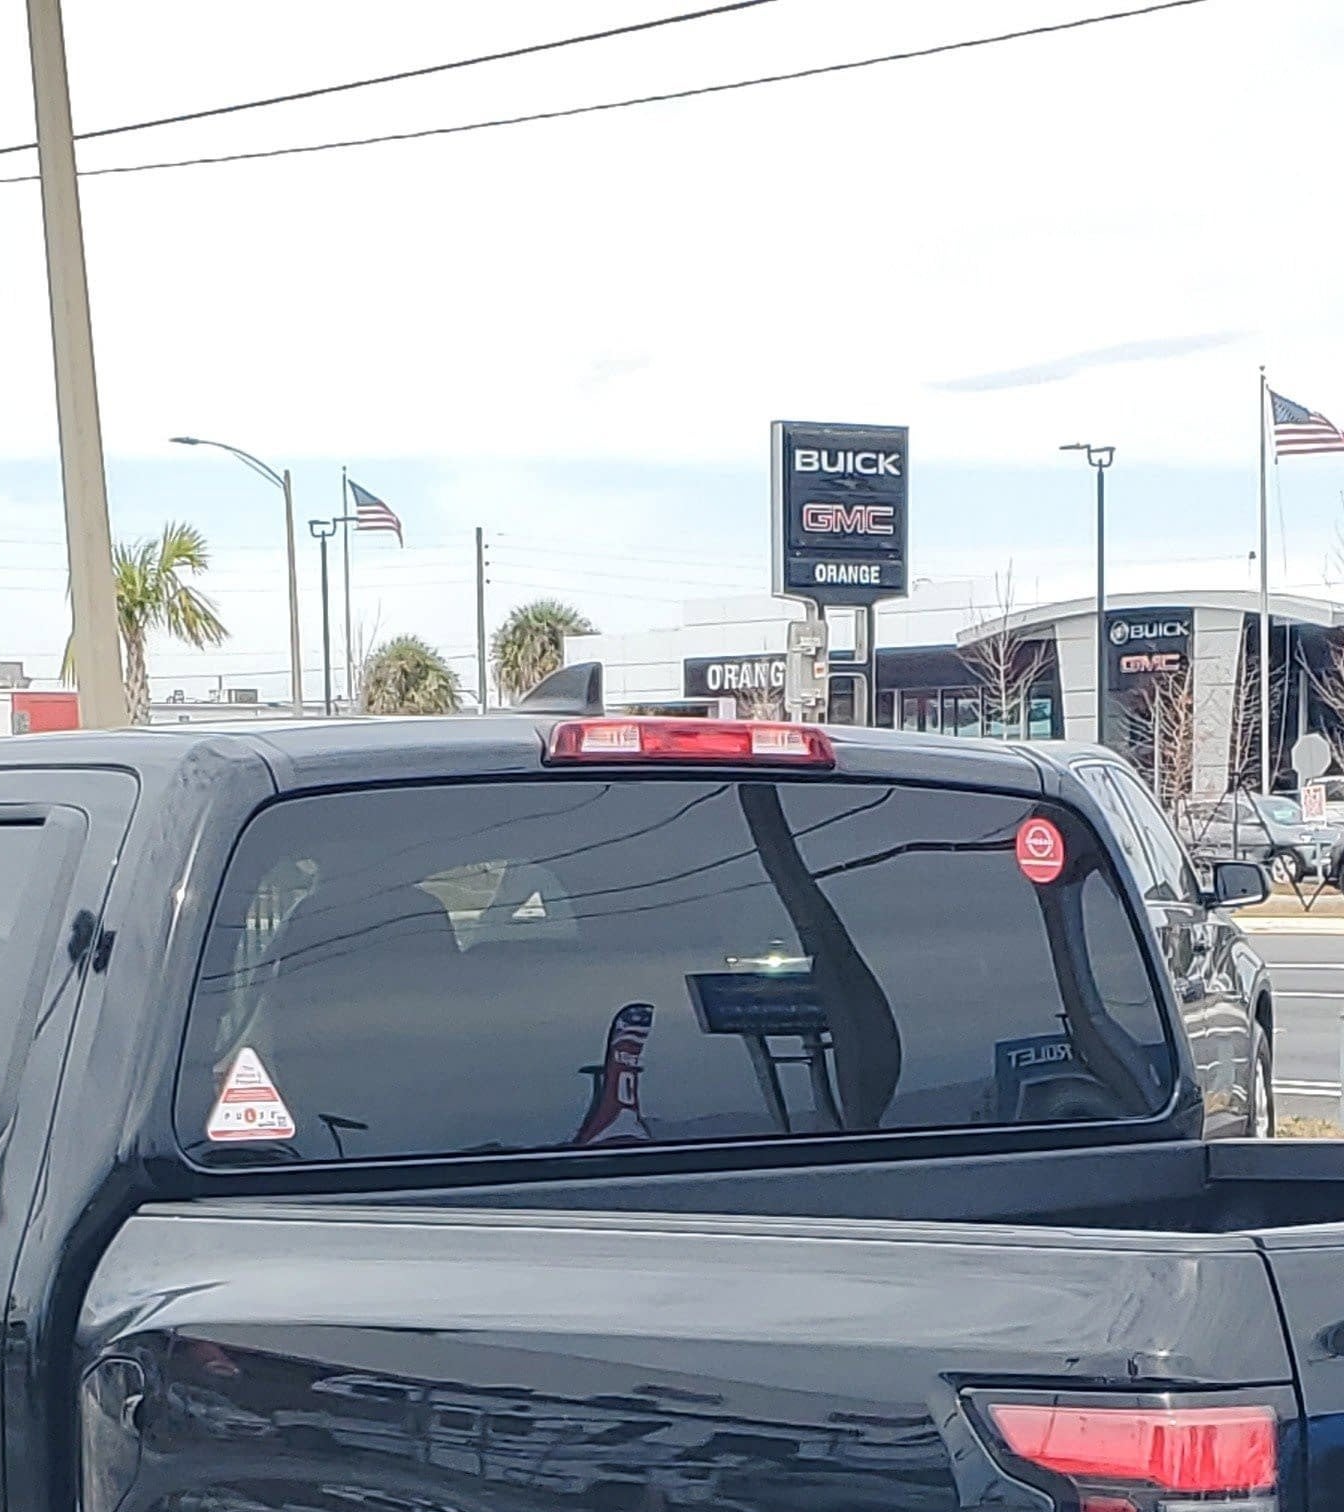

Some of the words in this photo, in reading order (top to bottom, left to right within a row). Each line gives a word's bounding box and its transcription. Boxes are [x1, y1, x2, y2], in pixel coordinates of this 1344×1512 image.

[794, 449, 901, 476] BUICK
[802, 502, 895, 535] GMC
[814, 563, 881, 584] ORANGE
[1130, 621, 1189, 639] BUICK
[707, 661, 787, 690] ORANG
[1119, 653, 1181, 674] GMC
